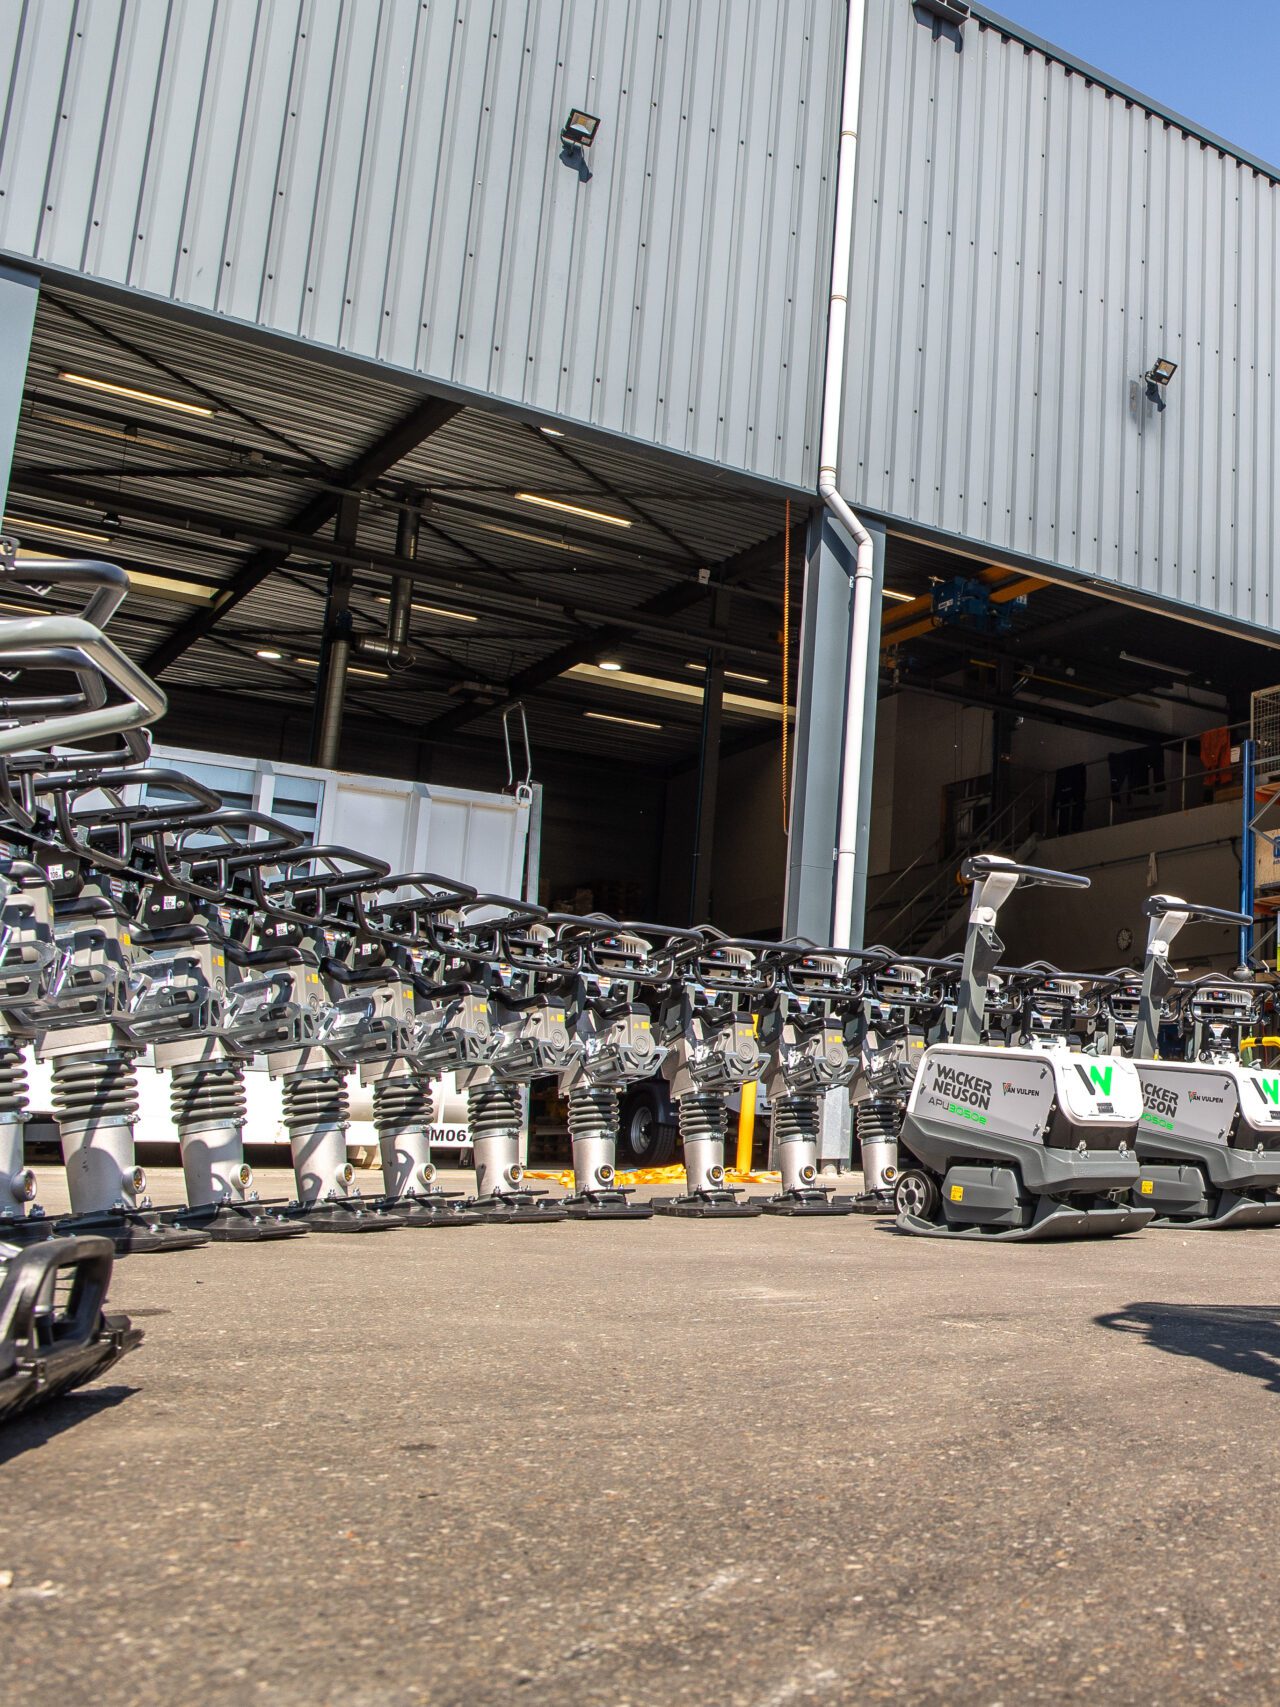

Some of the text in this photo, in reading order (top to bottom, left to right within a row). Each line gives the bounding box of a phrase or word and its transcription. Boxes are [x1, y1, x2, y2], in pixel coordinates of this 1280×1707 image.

[937, 1063, 993, 1096] WACKER
[1016, 1087, 1040, 1097] VULPEN
[932, 1077, 991, 1110] NEUSON
[1140, 1080, 1179, 1106] CKER
[1142, 1094, 1178, 1119] USON
[430, 1129, 473, 1142] M06
